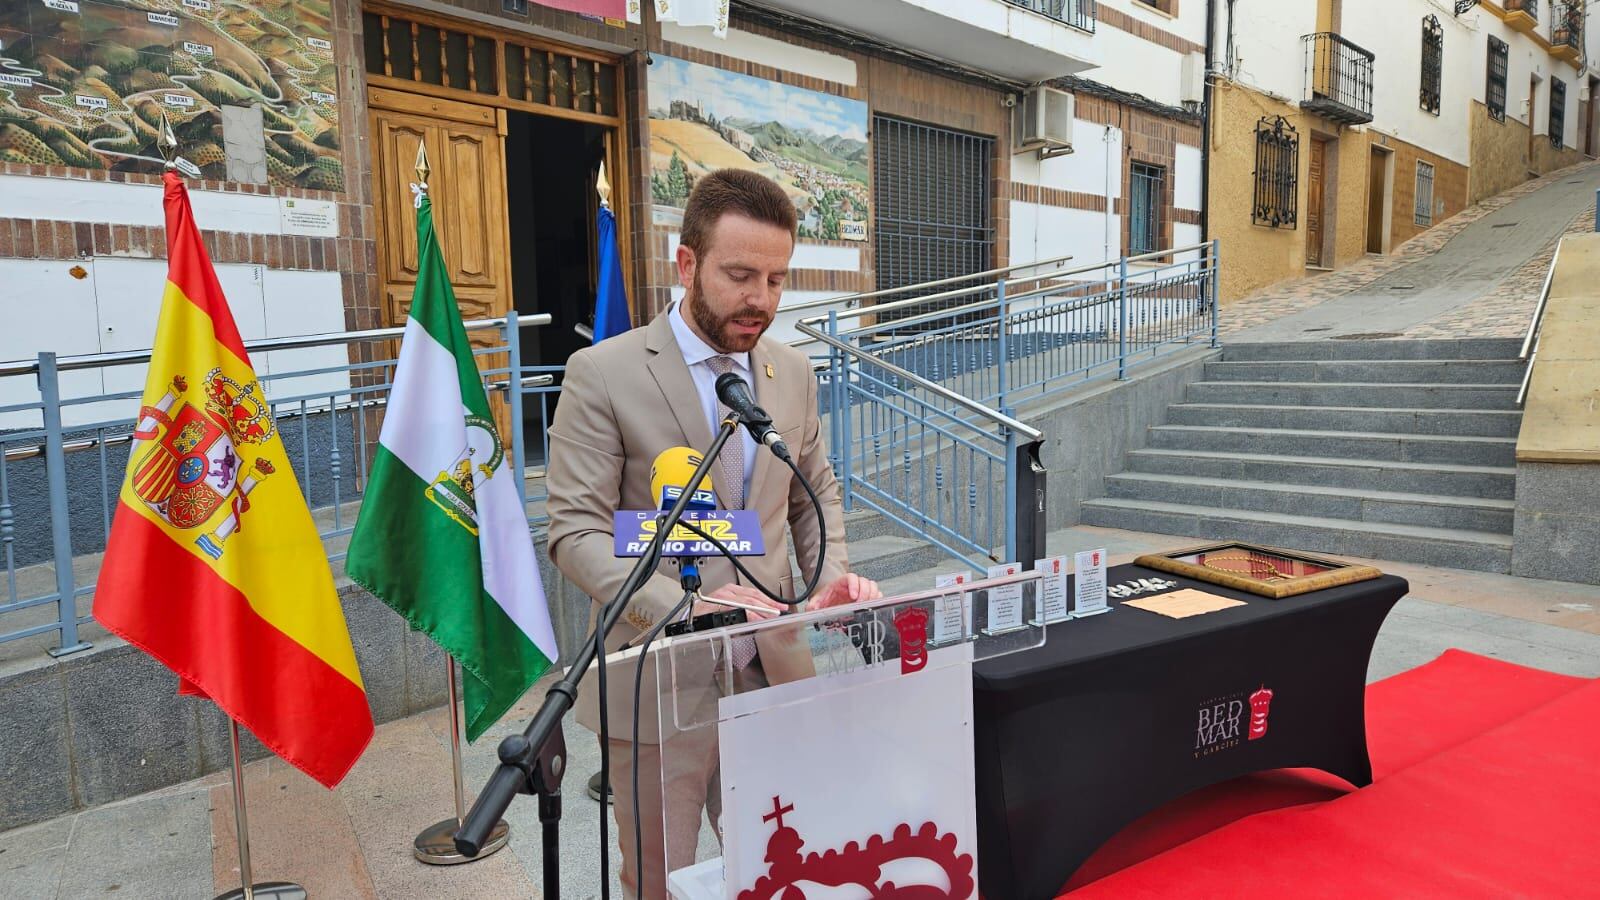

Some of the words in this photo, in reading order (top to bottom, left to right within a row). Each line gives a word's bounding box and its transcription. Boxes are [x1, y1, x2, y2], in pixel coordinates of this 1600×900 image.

[626, 541, 685, 553] RAIO
[1199, 700, 1243, 730] BED
[1195, 717, 1240, 749] MAR
